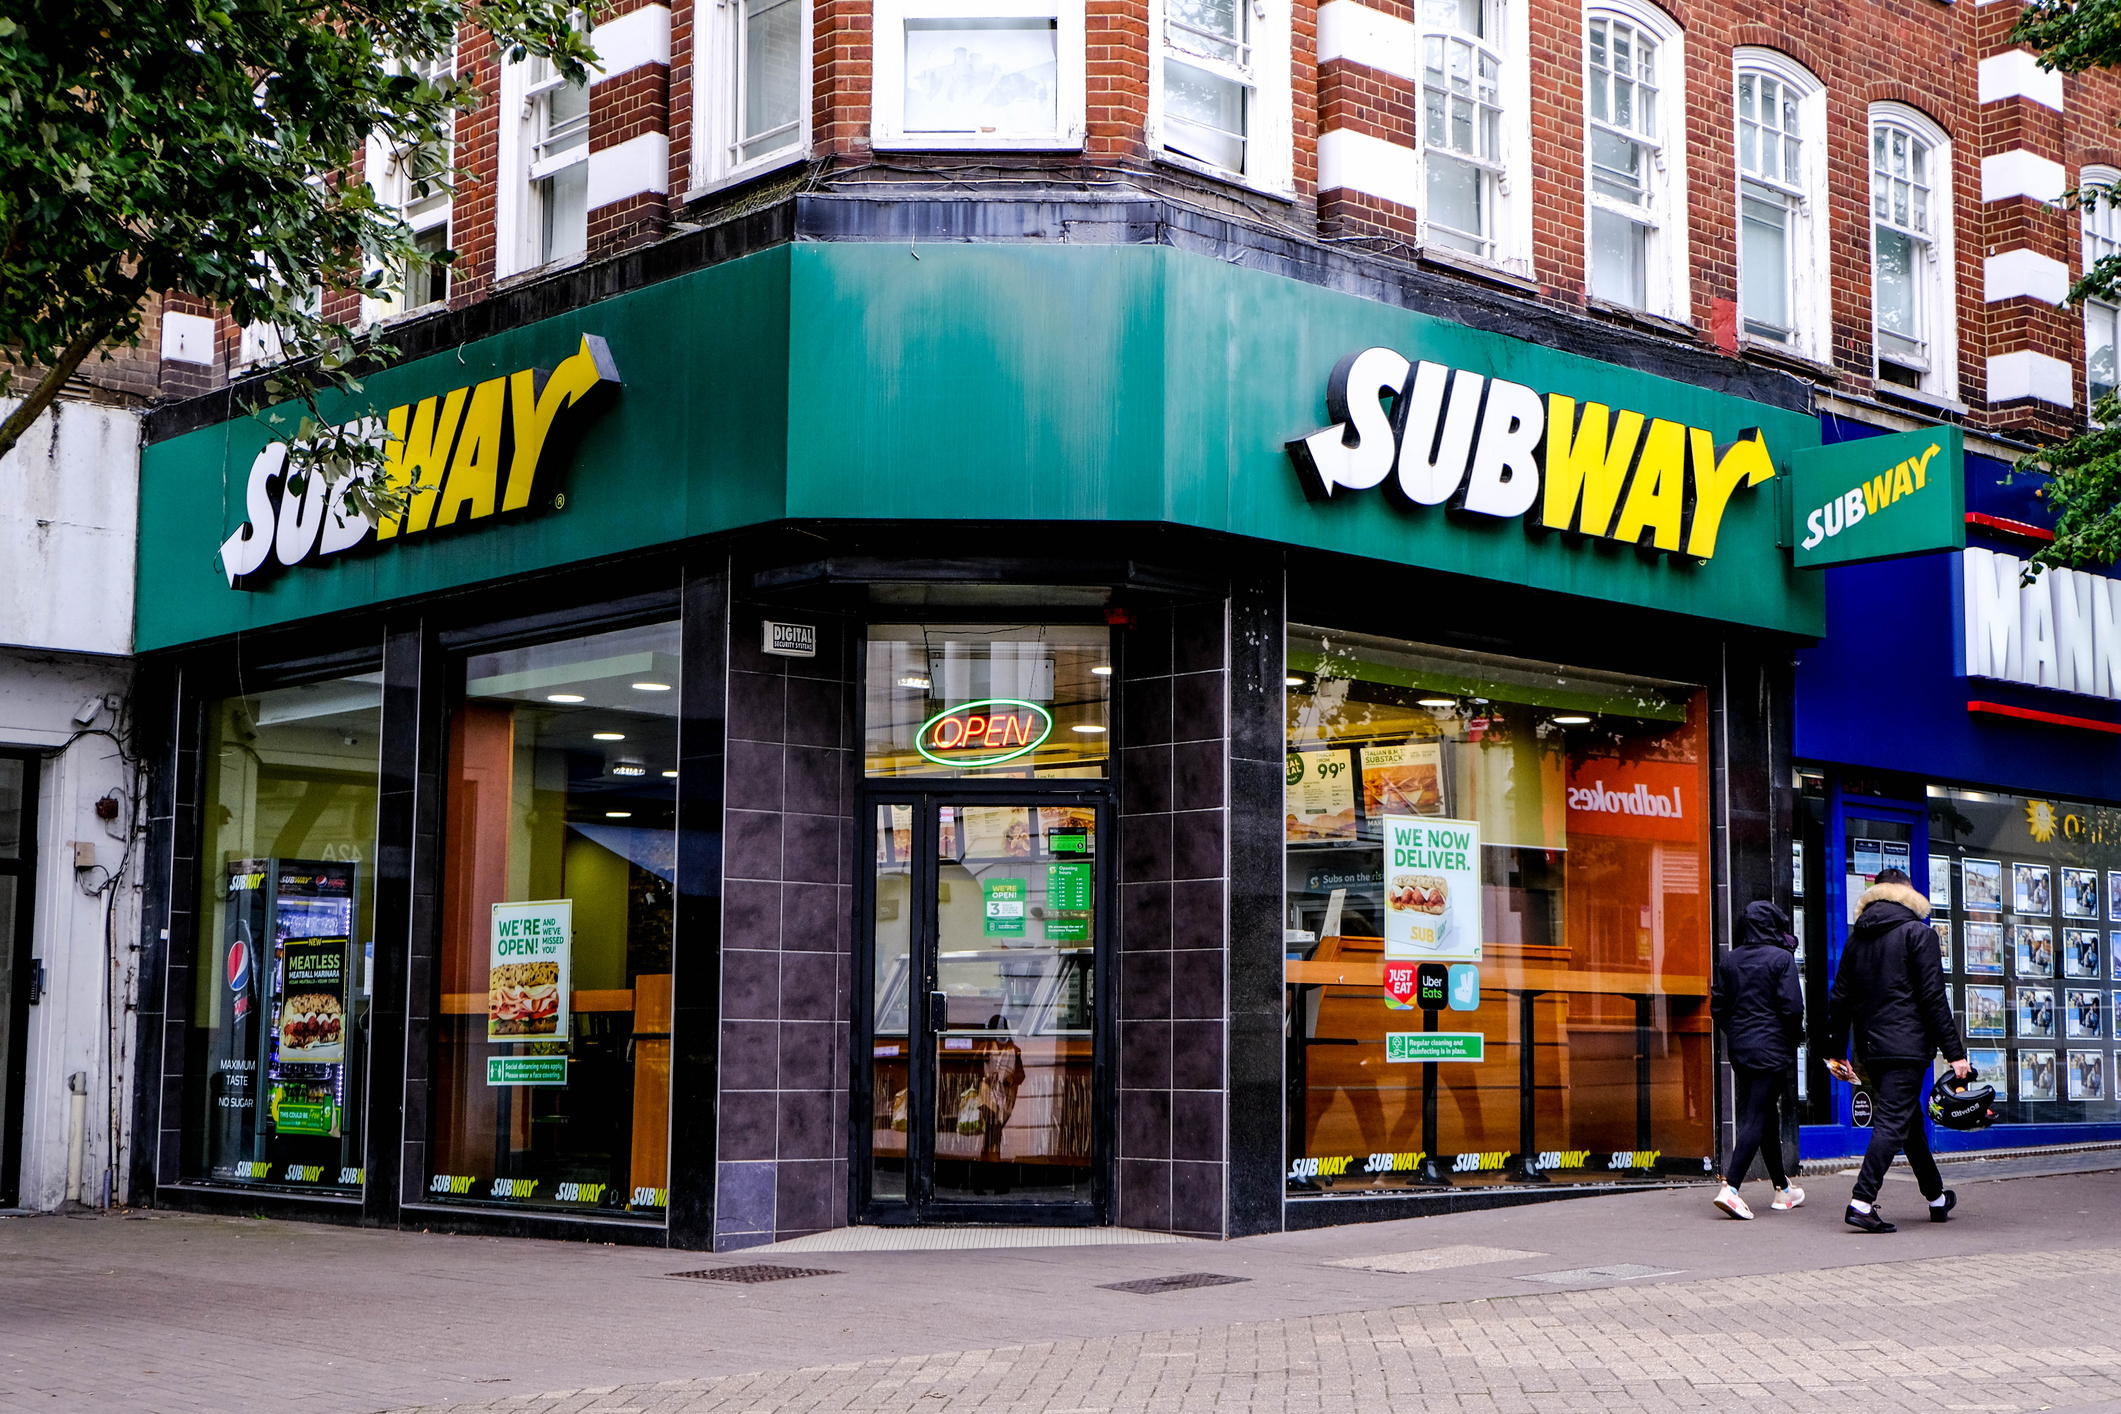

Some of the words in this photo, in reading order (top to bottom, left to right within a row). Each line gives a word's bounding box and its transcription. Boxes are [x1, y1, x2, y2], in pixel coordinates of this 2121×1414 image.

[1292, 346, 1776, 560] SUBWAY
[219, 333, 616, 590] SUBWAY
[1801, 442, 1941, 551] SUBWAY
[1964, 547, 2121, 701] MANN
[774, 626, 812, 643] DIGITAL
[774, 640, 795, 649] SECURITY
[795, 641, 813, 650] SYSTEMS
[933, 714, 1033, 750] OPEN
[1286, 759, 1300, 769] EAL
[1365, 755, 1404, 764] SUBSTACK
[1286, 765, 1302, 776] EAL
[1317, 762, 1346, 779] 99p
[1394, 827, 1423, 847] WE
[1428, 829, 1470, 850] NOW
[1394, 848, 1471, 871] DELIVER.
[229, 872, 265, 891] SUBWAY
[279, 875, 312, 885] SUBWAY
[1323, 874, 1343, 884] Subs
[1356, 872, 1370, 881] the
[1371, 871, 1384, 881] ris
[992, 885, 1017, 893] WE'RE
[990, 902, 1001, 916] 3
[498, 918, 541, 937] WE'RE
[542, 918, 556, 927] AND
[542, 927, 562, 936] WE'VE
[1410, 926, 1435, 944] SUB
[308, 938, 322, 946] NEW
[498, 937, 539, 956] OPEN!
[542, 936, 565, 945] MISSED
[541, 946, 557, 954] YOU!
[289, 954, 341, 970] MEATLESS
[289, 971, 314, 979] MEATBALL
[314, 969, 340, 978] MARINARA
[1389, 969, 1413, 983] JUST
[1422, 975, 1442, 987] Uber
[1393, 982, 1413, 994] EAT
[1422, 987, 1442, 999] Eats
[1409, 1039, 1430, 1048] Regular
[1430, 1039, 1452, 1047] cleaning
[1409, 1047, 1440, 1056] disinfecting
[1451, 1047, 1467, 1056] place.
[220, 1059, 256, 1070] MAXIMUM
[518, 1063, 539, 1071] distancing
[226, 1075, 249, 1086] TASTE
[218, 1097, 229, 1107] NO
[230, 1097, 254, 1108] SUGAR
[289, 1111, 302, 1119] COULD
[1288, 1155, 1354, 1178] SUBWAY
[1364, 1151, 1427, 1173] SUBWAY
[1452, 1150, 1511, 1172] SUBWAY
[1535, 1149, 1591, 1170] SUBWAY
[1608, 1149, 1661, 1169] SUBWAY
[234, 1160, 273, 1178] SUBWAY
[285, 1164, 325, 1183] SUBWAY
[338, 1167, 364, 1184] SUBW
[430, 1175, 476, 1194] SUBWAY
[490, 1178, 539, 1198] SUBWAY
[555, 1182, 607, 1202] SUBWAY
[630, 1187, 667, 1207] SUBW
